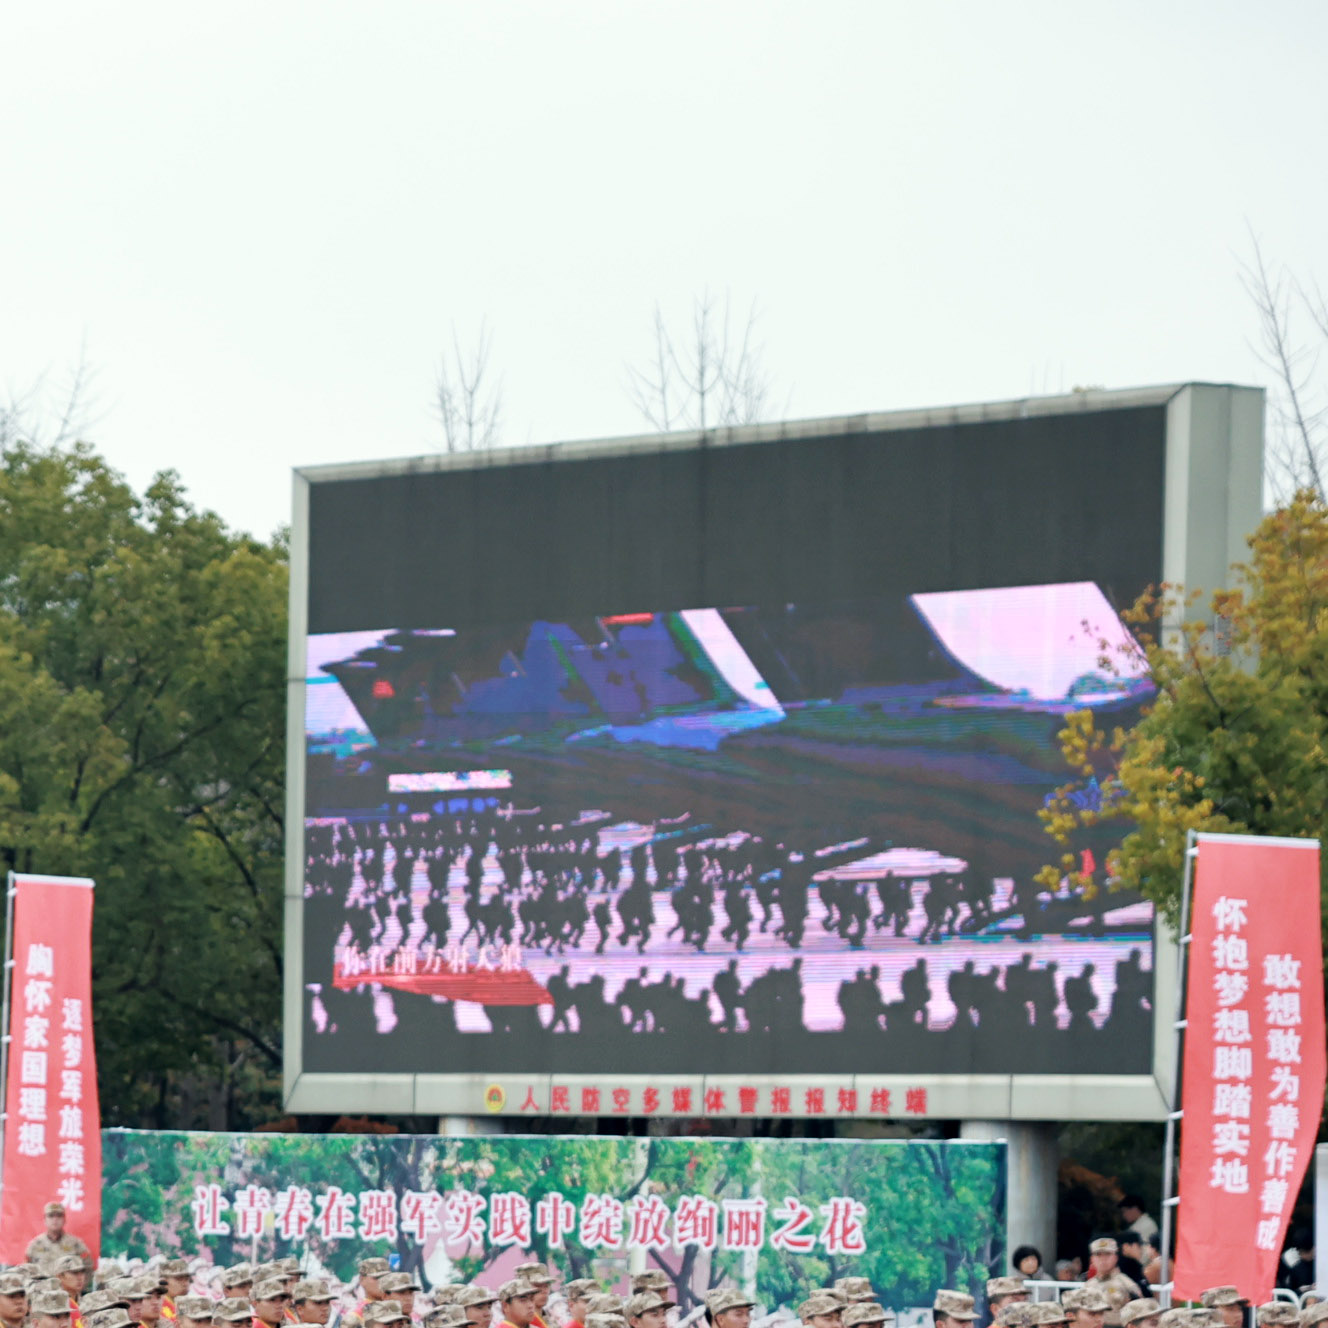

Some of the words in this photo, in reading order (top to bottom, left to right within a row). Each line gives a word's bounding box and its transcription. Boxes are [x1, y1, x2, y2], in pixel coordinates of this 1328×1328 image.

[18, 943, 54, 1158] 胸怀家国理想
[1209, 895, 1253, 1195] 怀抱梦想脚踏实地
[1256, 953, 1302, 1250] 敢想敢为善作善成
[193, 1183, 867, 1253] 让青春在强军实践中绽放绚丽之花
